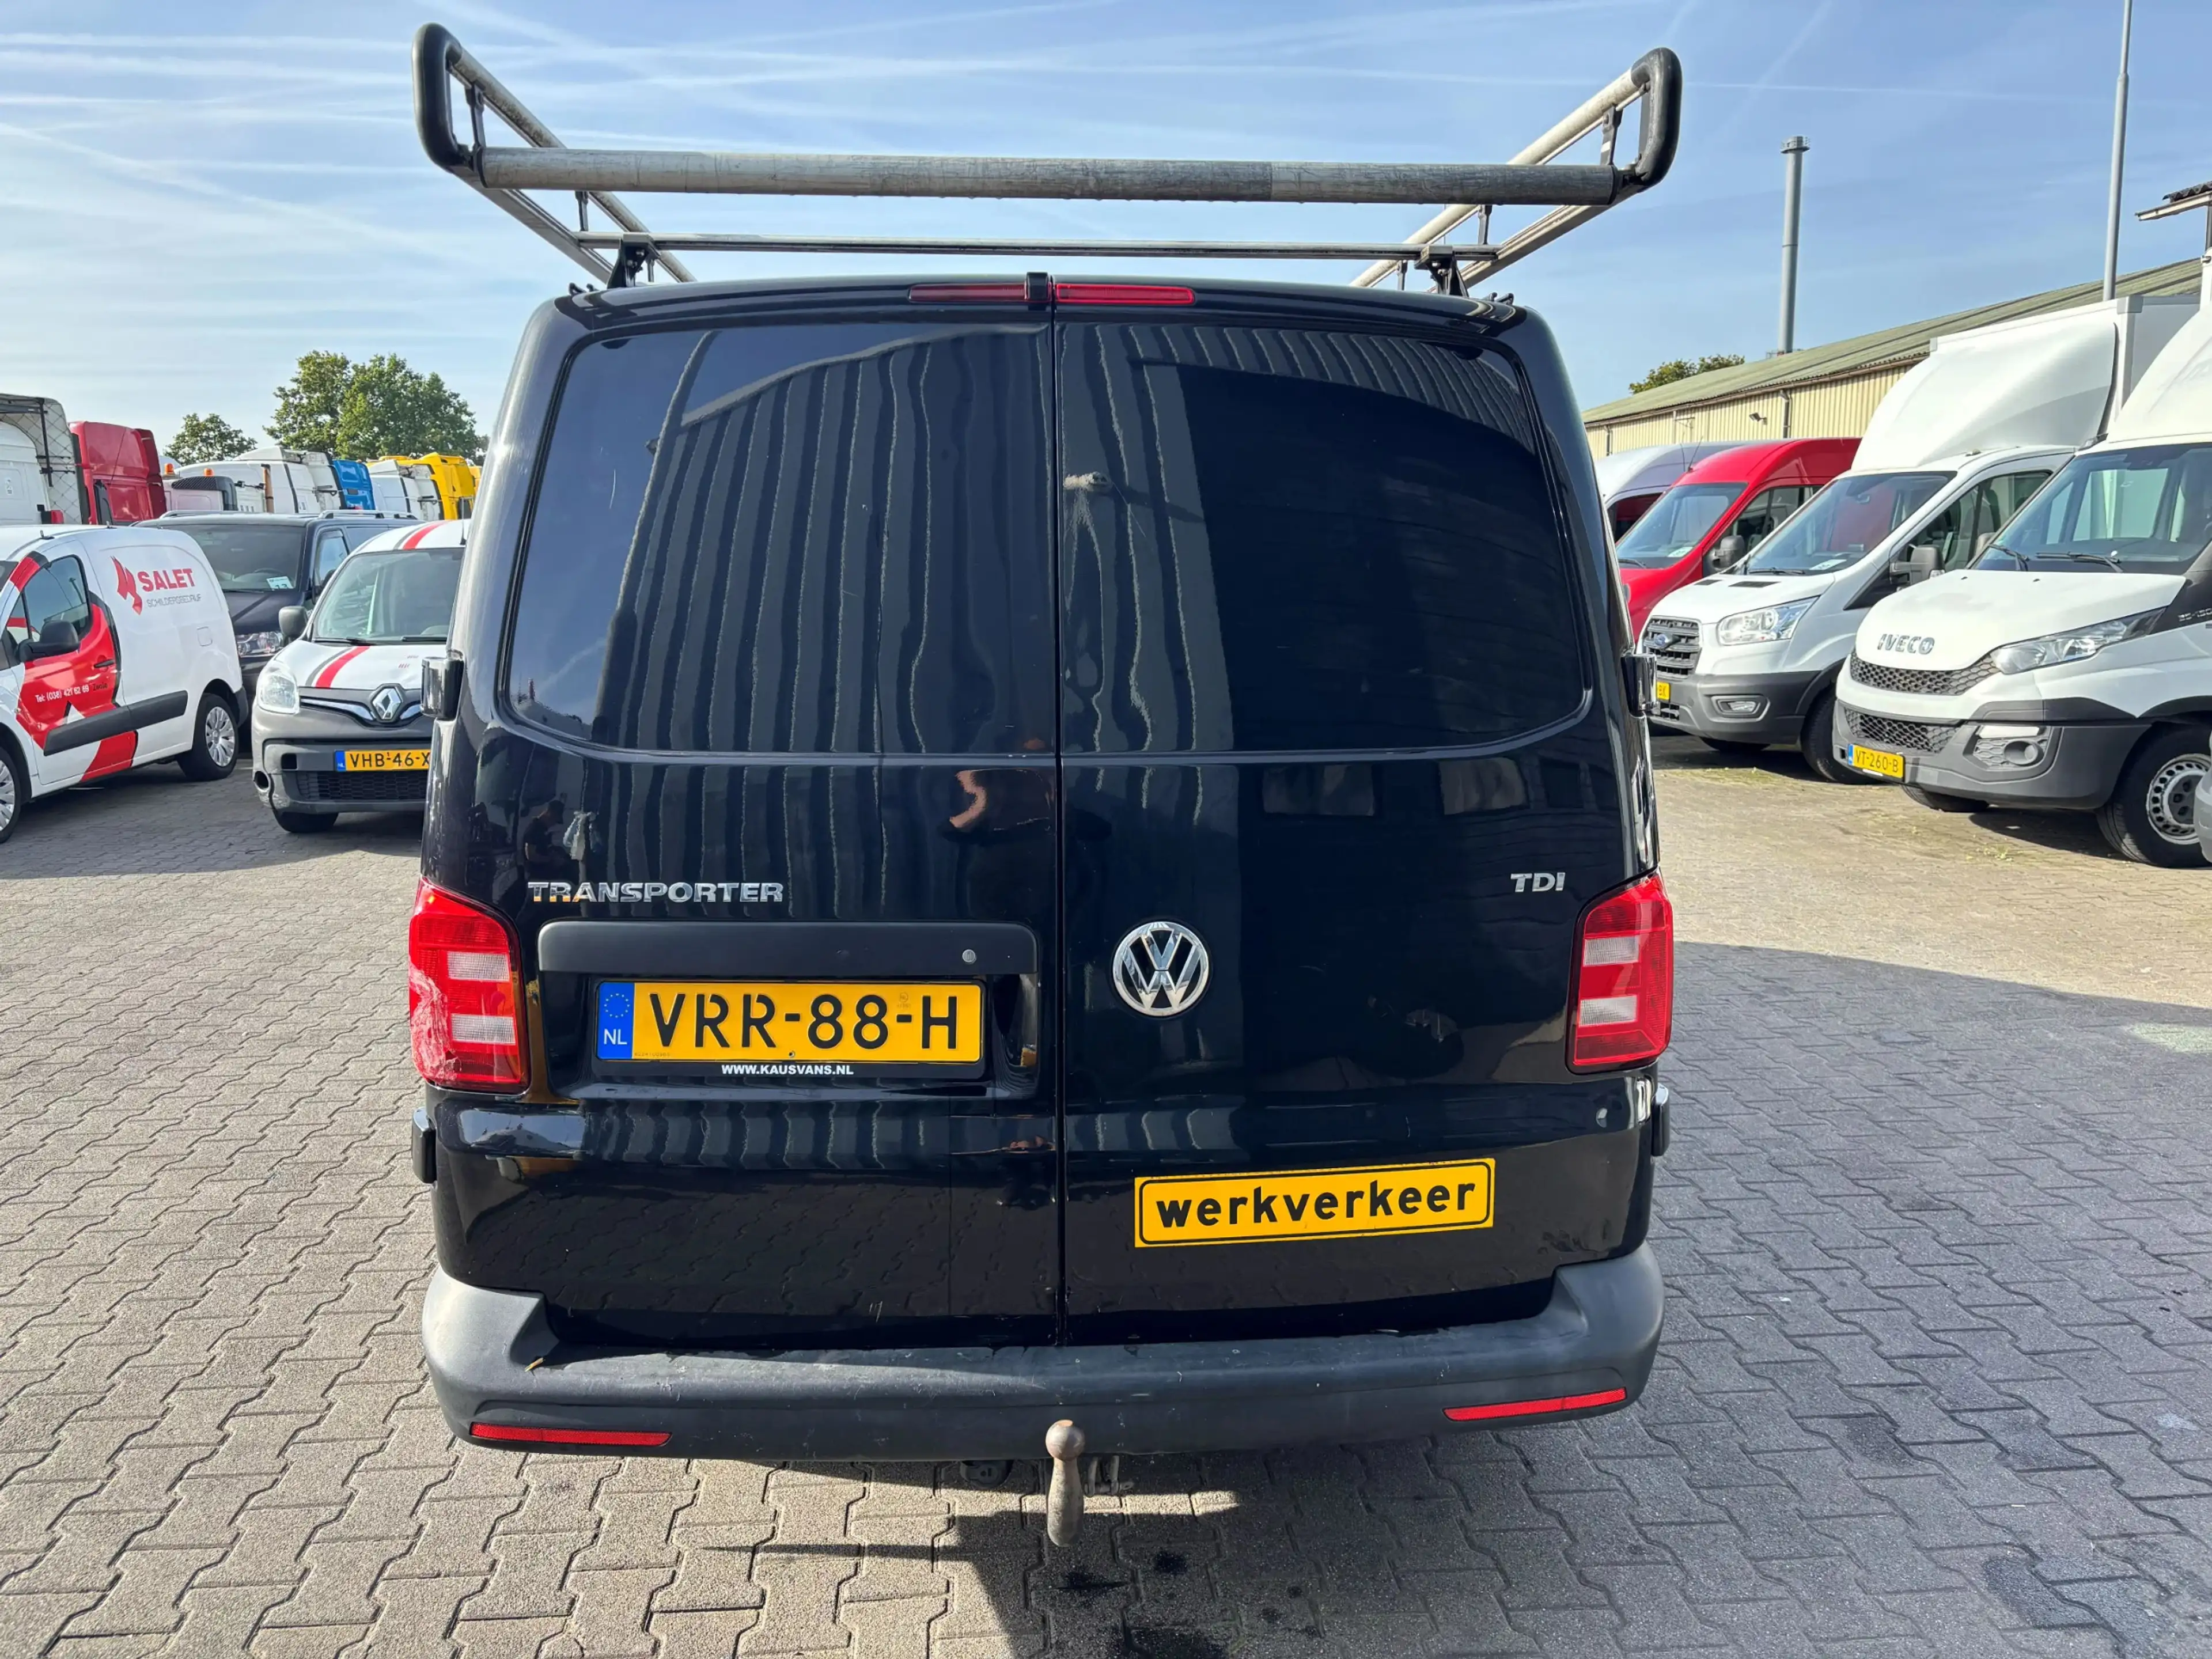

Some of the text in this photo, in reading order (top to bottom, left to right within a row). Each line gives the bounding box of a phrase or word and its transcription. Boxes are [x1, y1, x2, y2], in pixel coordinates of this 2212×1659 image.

[137, 568, 195, 592] SALET
[1877, 633, 1935, 655] IVECO
[47, 690, 62, 702] (038)
[349, 752, 431, 768] VHB-46-X
[528, 881, 784, 903] TRANSPORTER
[1510, 872, 1566, 892] TDI
[603, 1028, 628, 1046] NL
[649, 993, 957, 1050] VRR-88-H
[721, 1064, 854, 1075] WWW.KAUSVANS.NL
[1156, 1180, 1476, 1228] werkverkeer
